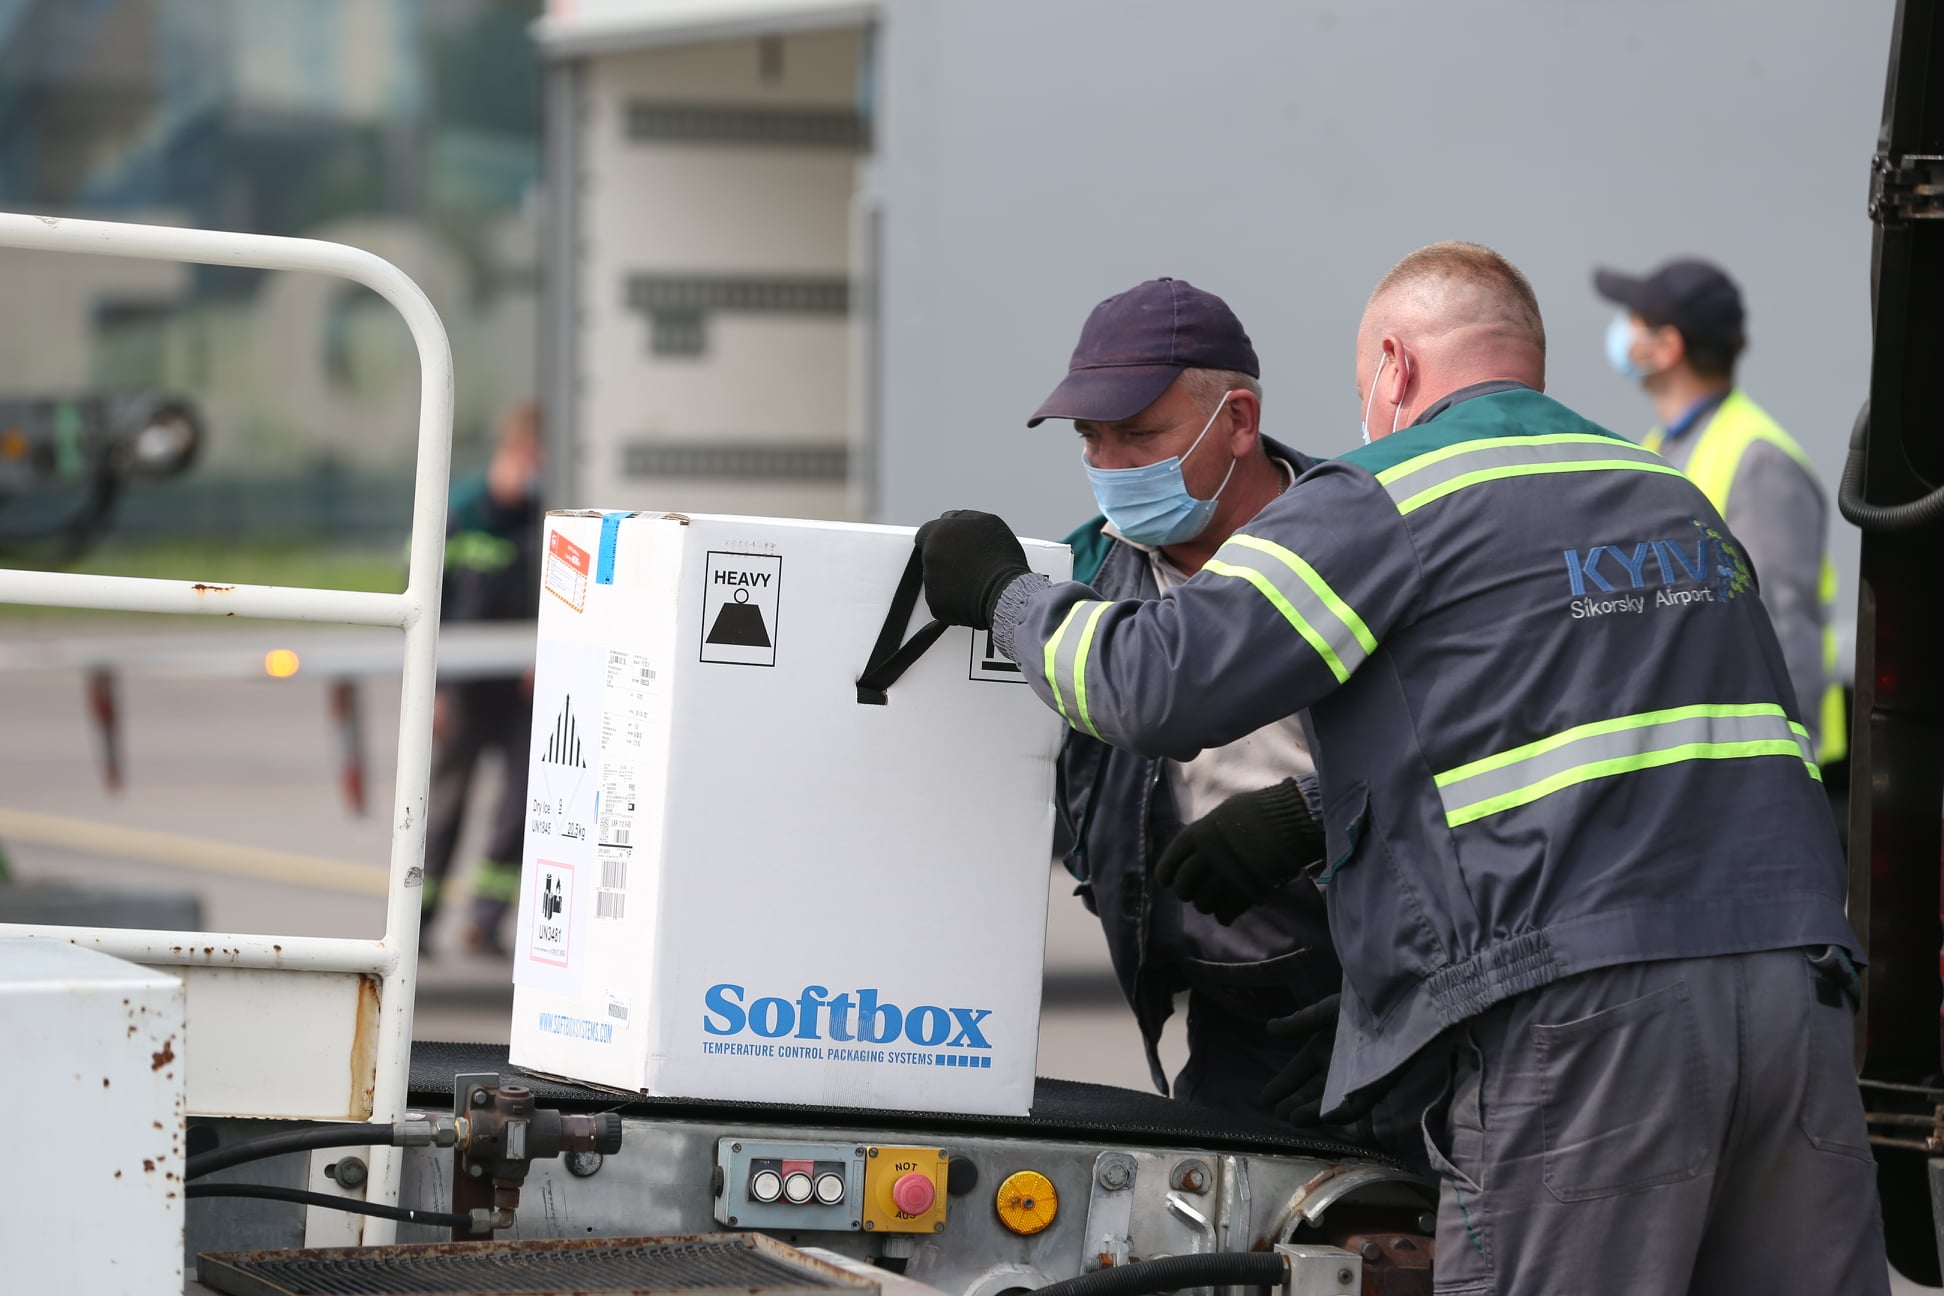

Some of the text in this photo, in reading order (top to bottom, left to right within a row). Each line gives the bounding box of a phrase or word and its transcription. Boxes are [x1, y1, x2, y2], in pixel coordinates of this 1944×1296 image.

[1564, 539, 1708, 596] KYIV
[714, 570, 771, 587] HEAVY
[1570, 586, 1714, 619] Sikorsky Airport
[532, 799, 543, 816] Dry
[531, 819, 552, 835] UN1845
[538, 923, 562, 943] UN3481
[703, 983, 992, 1049] Softbox
[702, 1041, 933, 1065] TEMPERATURE CONTROL PACKAGING SYSTEMS
[895, 1162, 918, 1172] NOT
